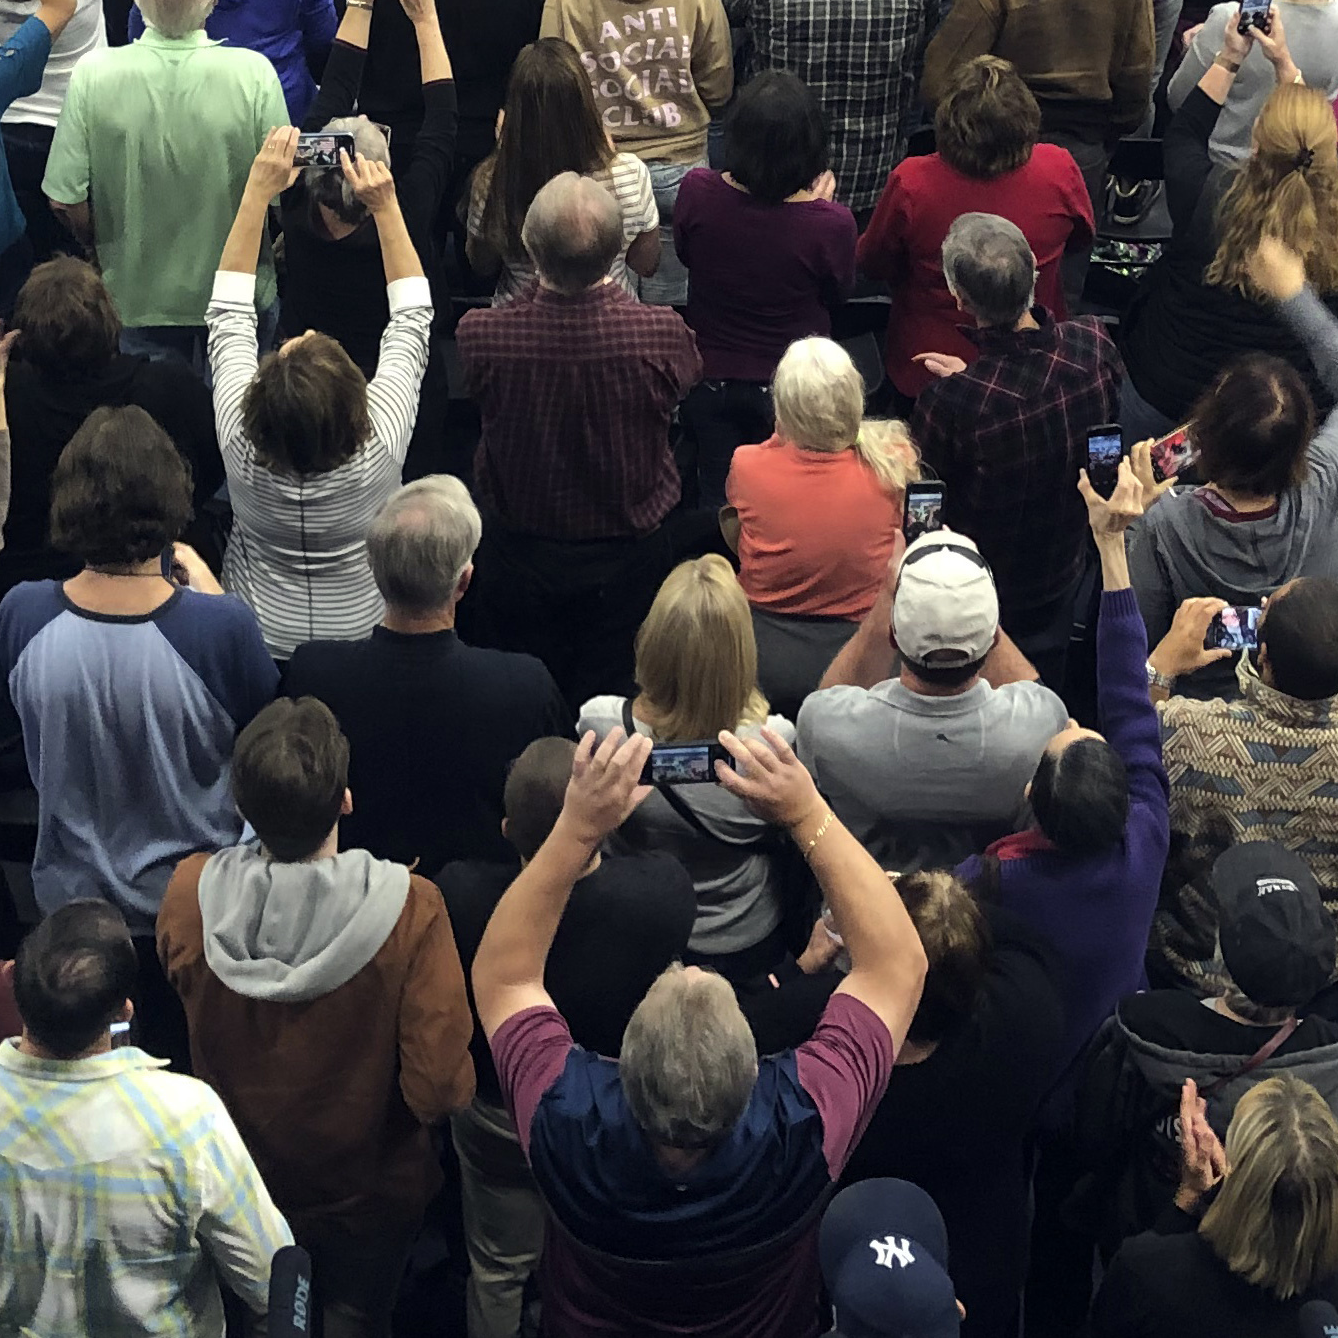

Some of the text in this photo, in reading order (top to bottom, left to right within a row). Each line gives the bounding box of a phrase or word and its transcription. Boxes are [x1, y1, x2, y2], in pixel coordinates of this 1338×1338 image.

[599, 6, 678, 44] ANTI
[579, 35, 691, 73] SOCIAL
[602, 101, 681, 128] CLUB
[869, 1235, 916, 1270] NY
